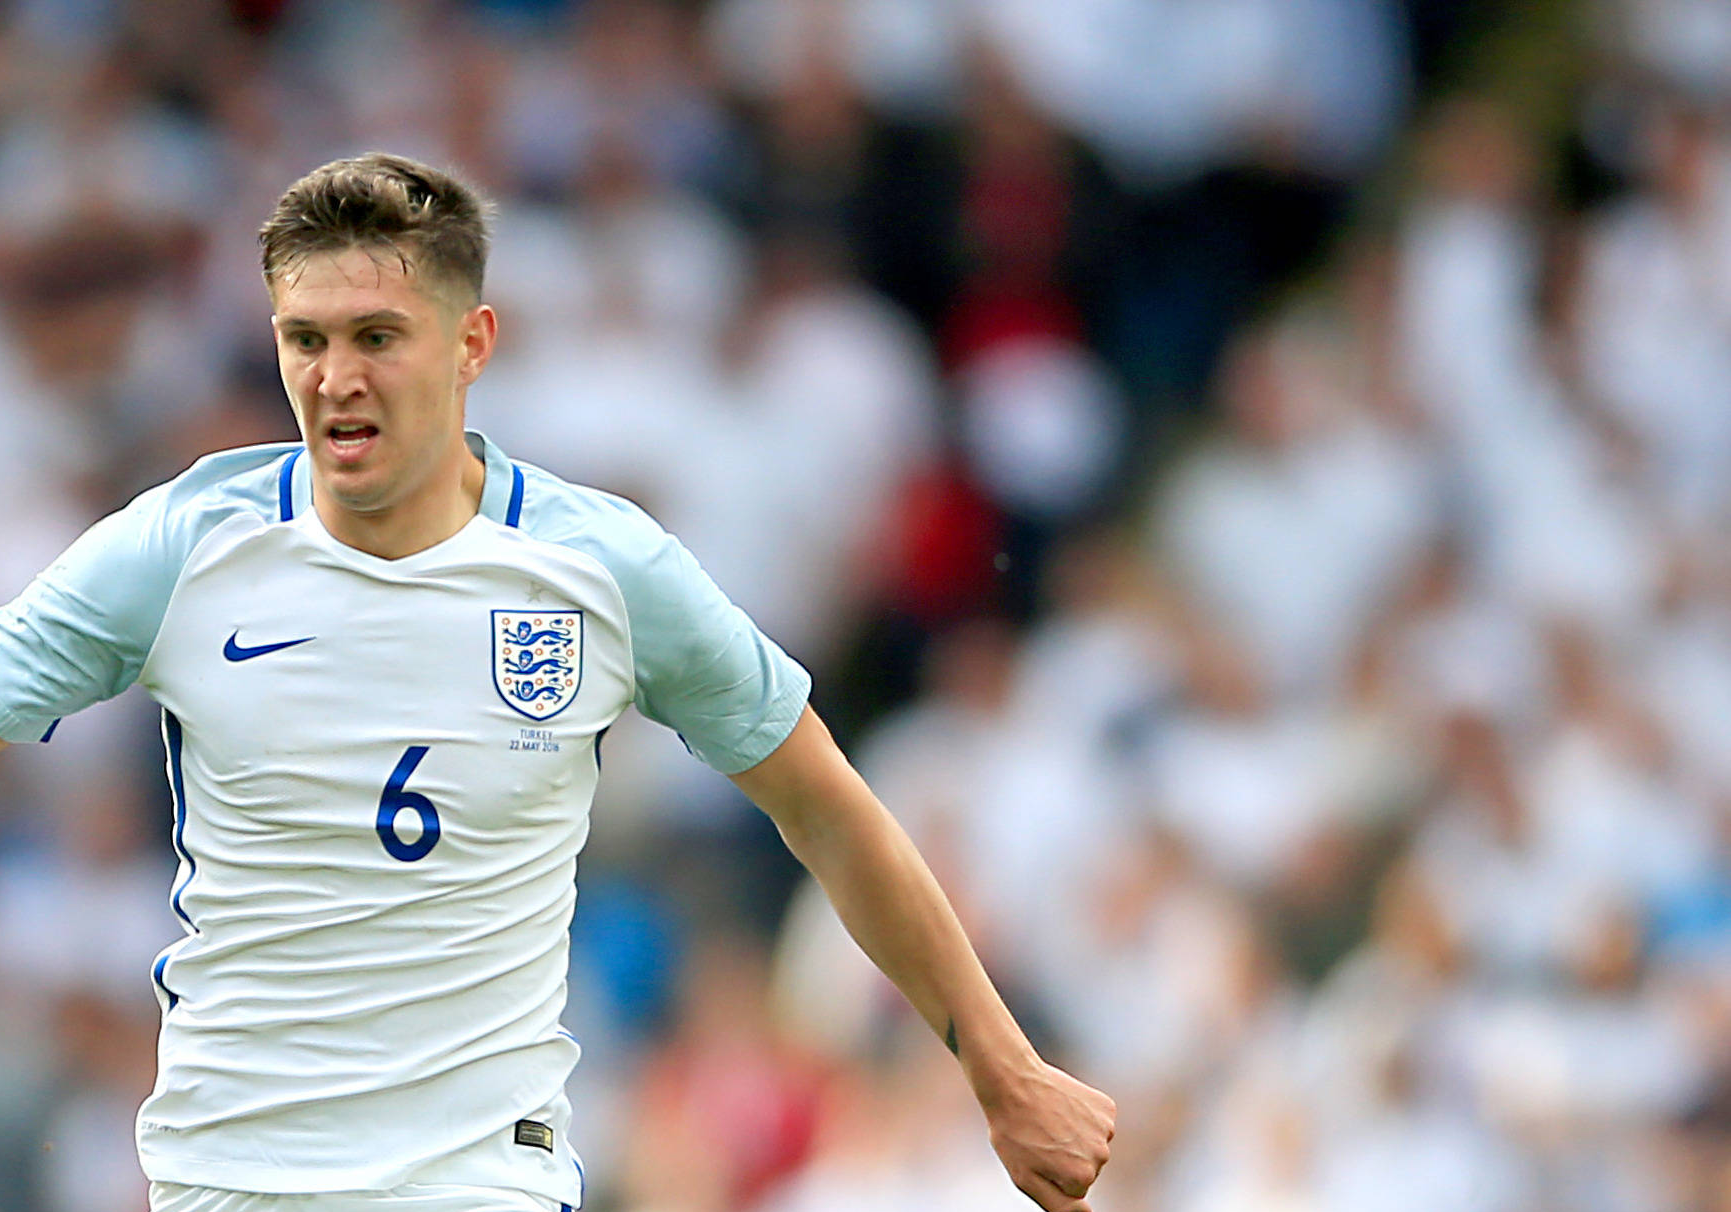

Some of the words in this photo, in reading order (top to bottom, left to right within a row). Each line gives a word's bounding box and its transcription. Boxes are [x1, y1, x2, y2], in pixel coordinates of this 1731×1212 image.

[520, 728, 553, 740] TURKEY
[510, 740, 520, 750] 22
[522, 741, 540, 751] MAY
[375, 746, 441, 862] 6
